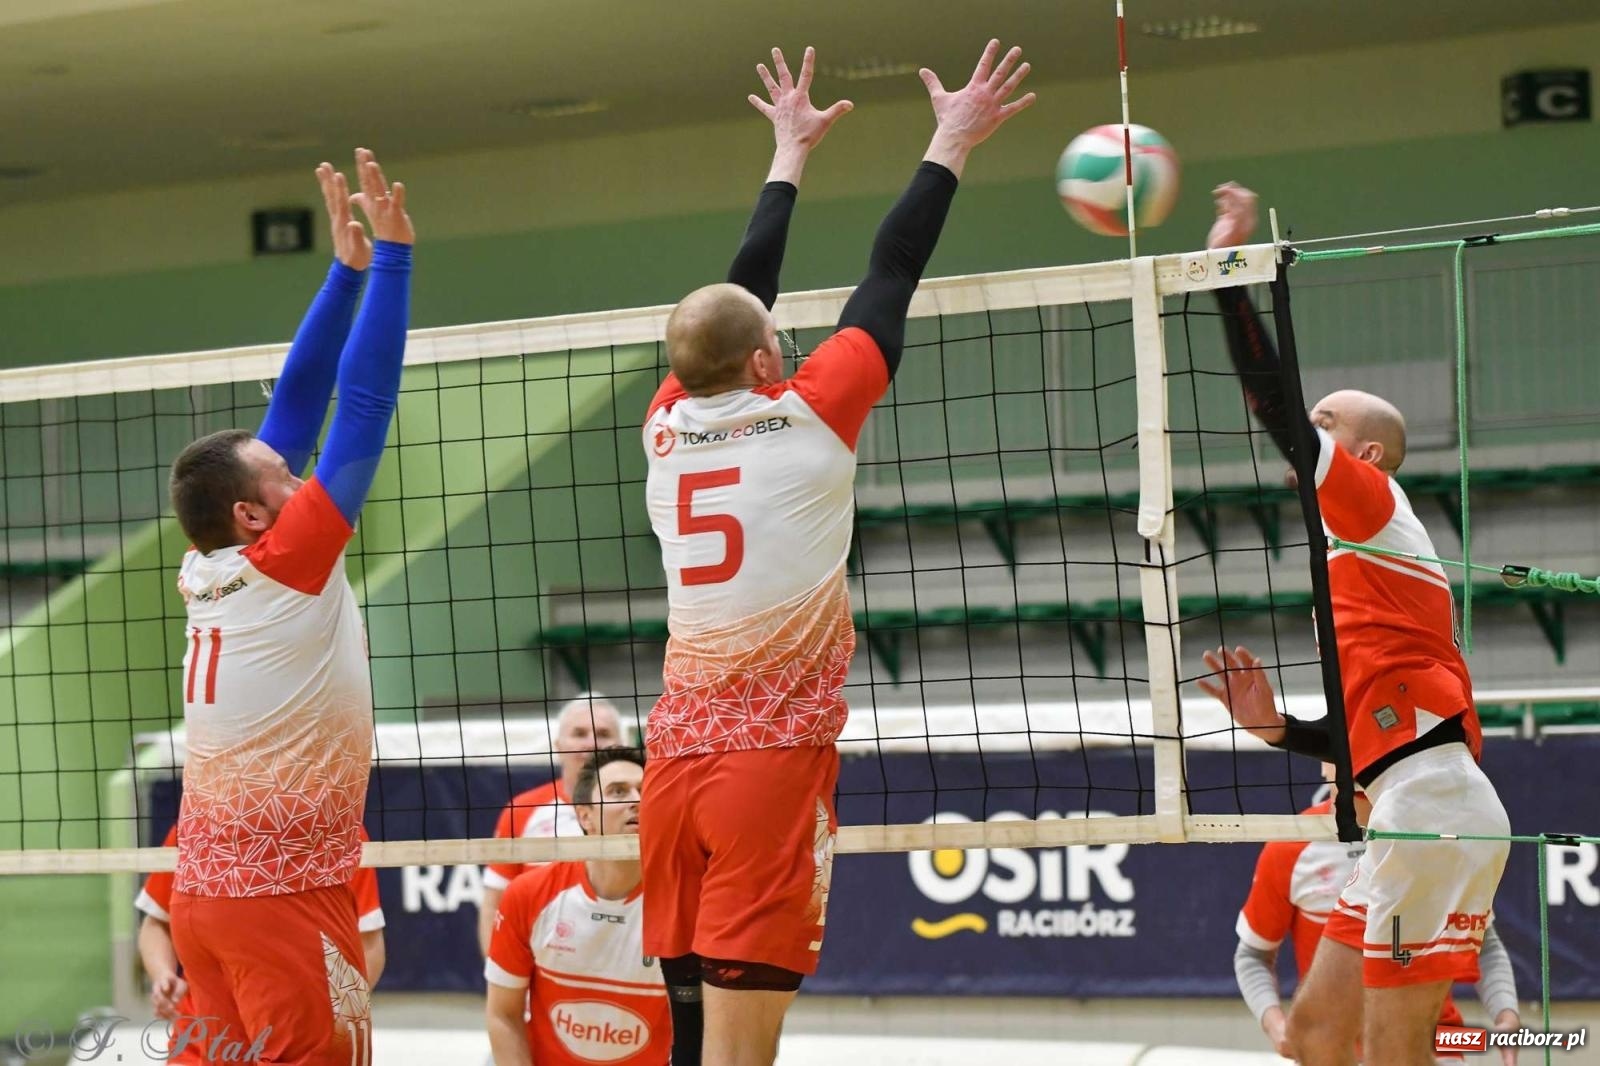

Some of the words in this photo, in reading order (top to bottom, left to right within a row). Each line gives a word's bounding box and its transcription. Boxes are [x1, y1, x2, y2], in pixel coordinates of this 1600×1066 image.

[1537, 85, 1579, 117] C
[731, 416, 792, 439] COBEX
[677, 467, 744, 586] 5
[187, 626, 221, 704] 11
[997, 902, 1136, 937] RACIBÓRZ
[556, 1009, 641, 1045] Henkel
